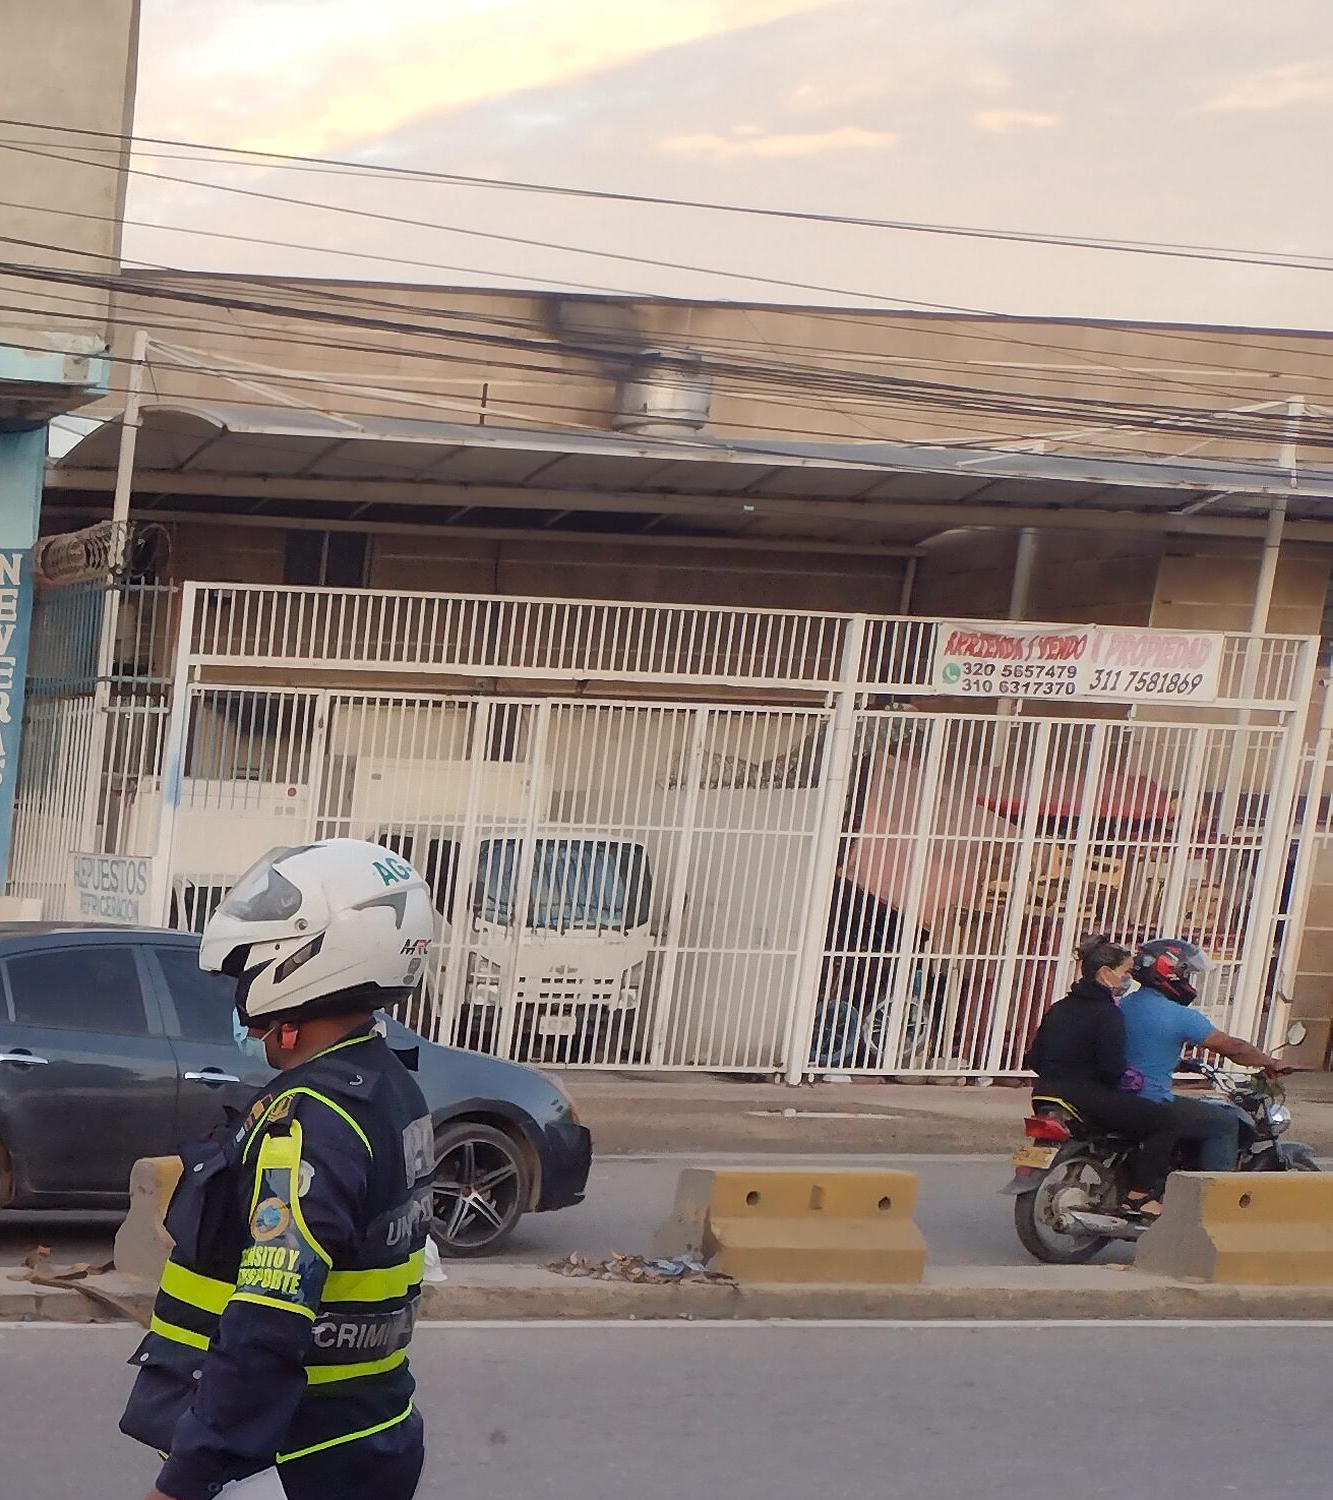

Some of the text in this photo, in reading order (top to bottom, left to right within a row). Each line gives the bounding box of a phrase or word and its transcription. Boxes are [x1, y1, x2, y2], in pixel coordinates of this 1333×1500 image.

[962, 662, 1077, 679] 320 5657479
[962, 678, 1076, 695] 310 6317370
[1089, 669, 1203, 695] 311 7581869
[287, 1250, 300, 1271] Y
